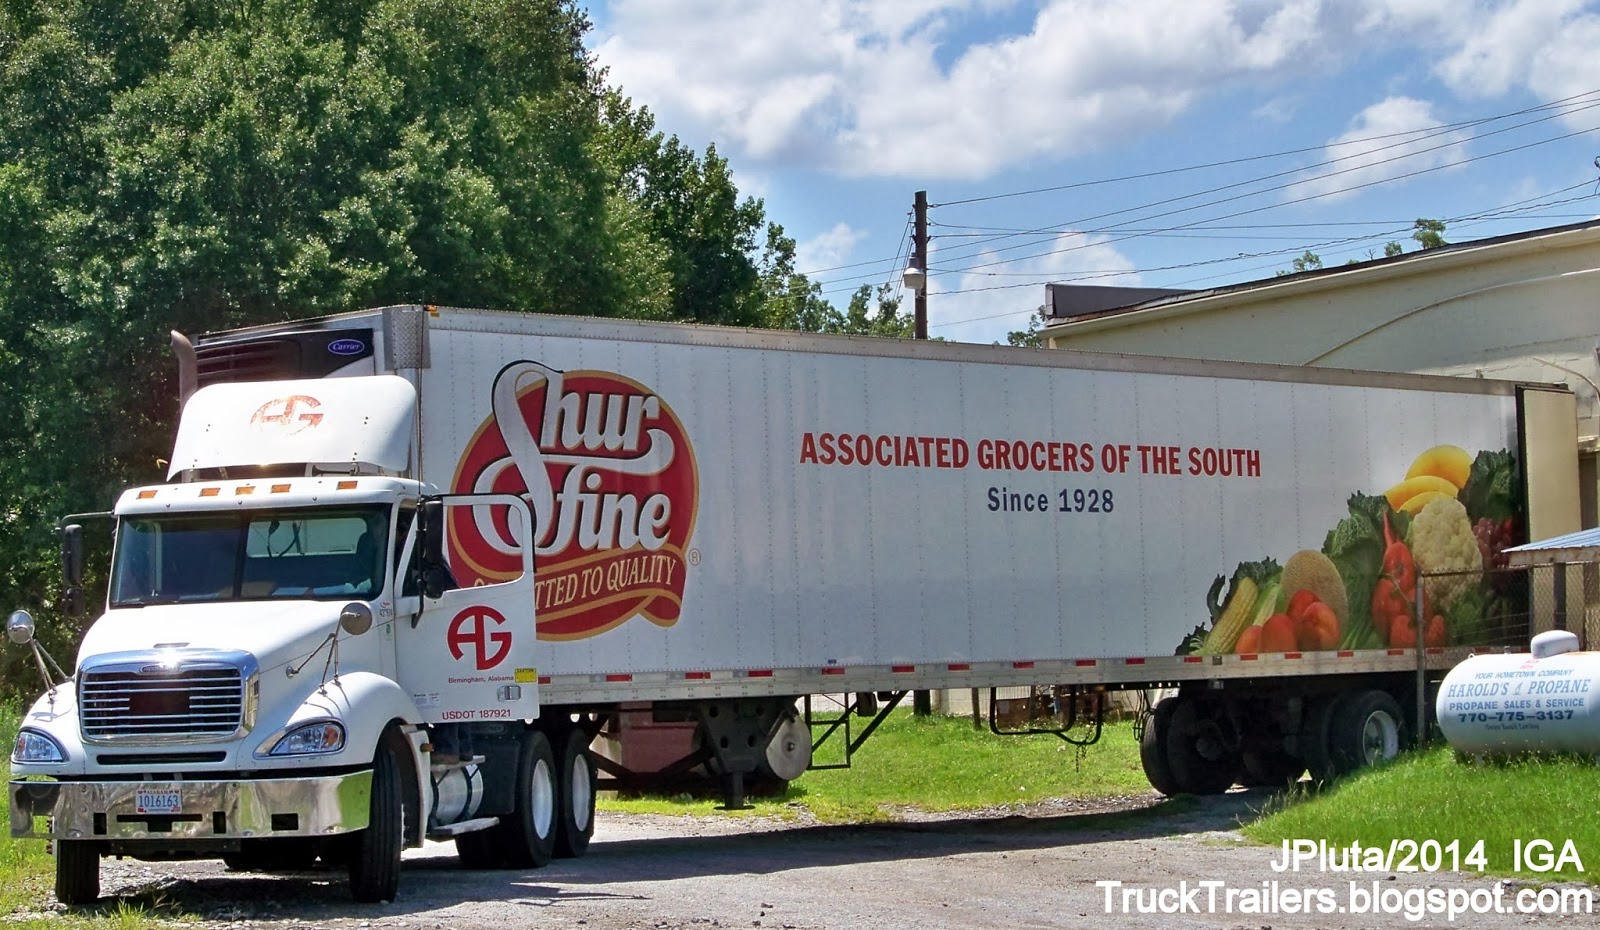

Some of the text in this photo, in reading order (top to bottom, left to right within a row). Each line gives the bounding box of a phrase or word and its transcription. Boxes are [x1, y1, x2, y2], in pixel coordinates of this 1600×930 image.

[800, 432, 1261, 477] ASSOCIATED GROCERS OF THE SOUTH
[987, 486, 1114, 513] Since 1928
[534, 463, 671, 556] fine
[581, 568, 603, 599] TO
[606, 554, 676, 592] QUALITY
[1474, 669, 1574, 680] YOUR HOMETOWN COMPANY
[1447, 679, 1591, 698] HAROLD'S PROPANE
[1450, 698, 1584, 711] PROPANE SALES & SERVICE
[442, 709, 511, 720] USDOT 187921
[1458, 710, 1574, 723] 770-775-3137
[139, 795, 179, 807] 1016163
